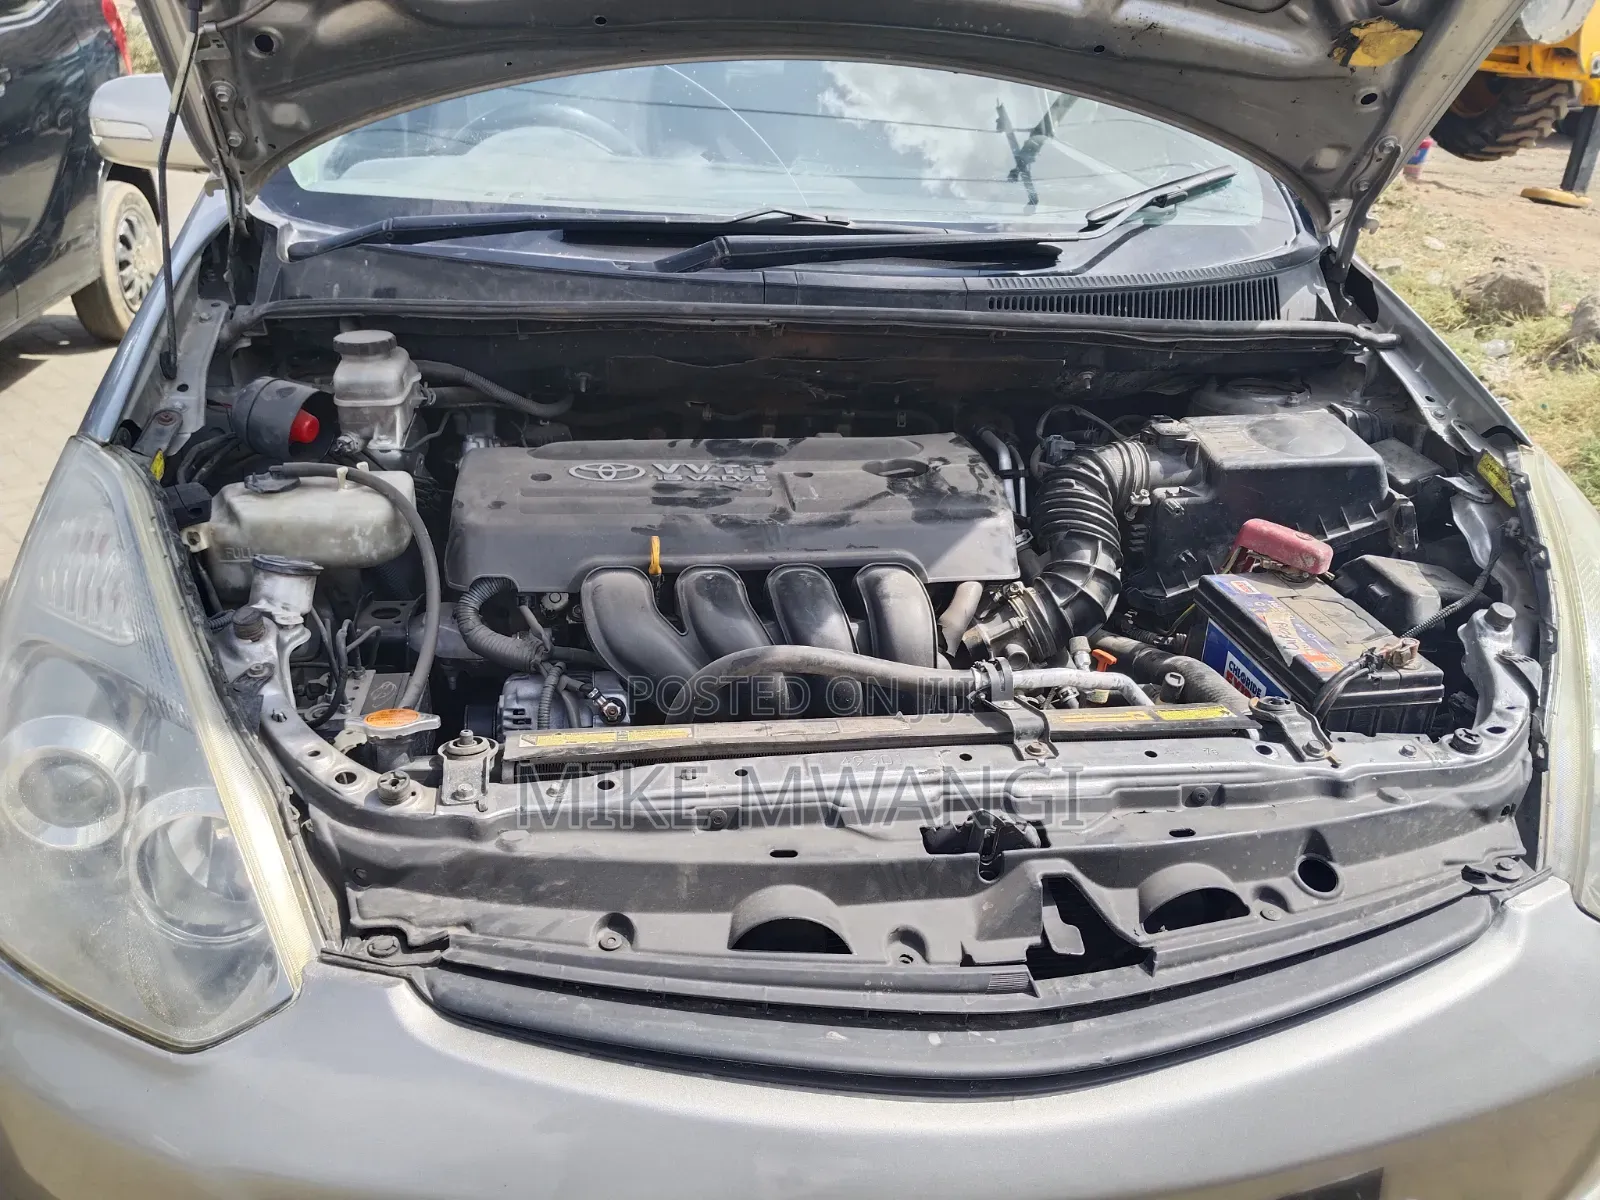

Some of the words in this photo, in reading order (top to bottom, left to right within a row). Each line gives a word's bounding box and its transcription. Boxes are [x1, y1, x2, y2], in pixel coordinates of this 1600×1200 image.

[687, 475, 768, 483] VALVE
[223, 547, 255, 559] FULL
[1228, 660, 1262, 698] CHLORIDE
